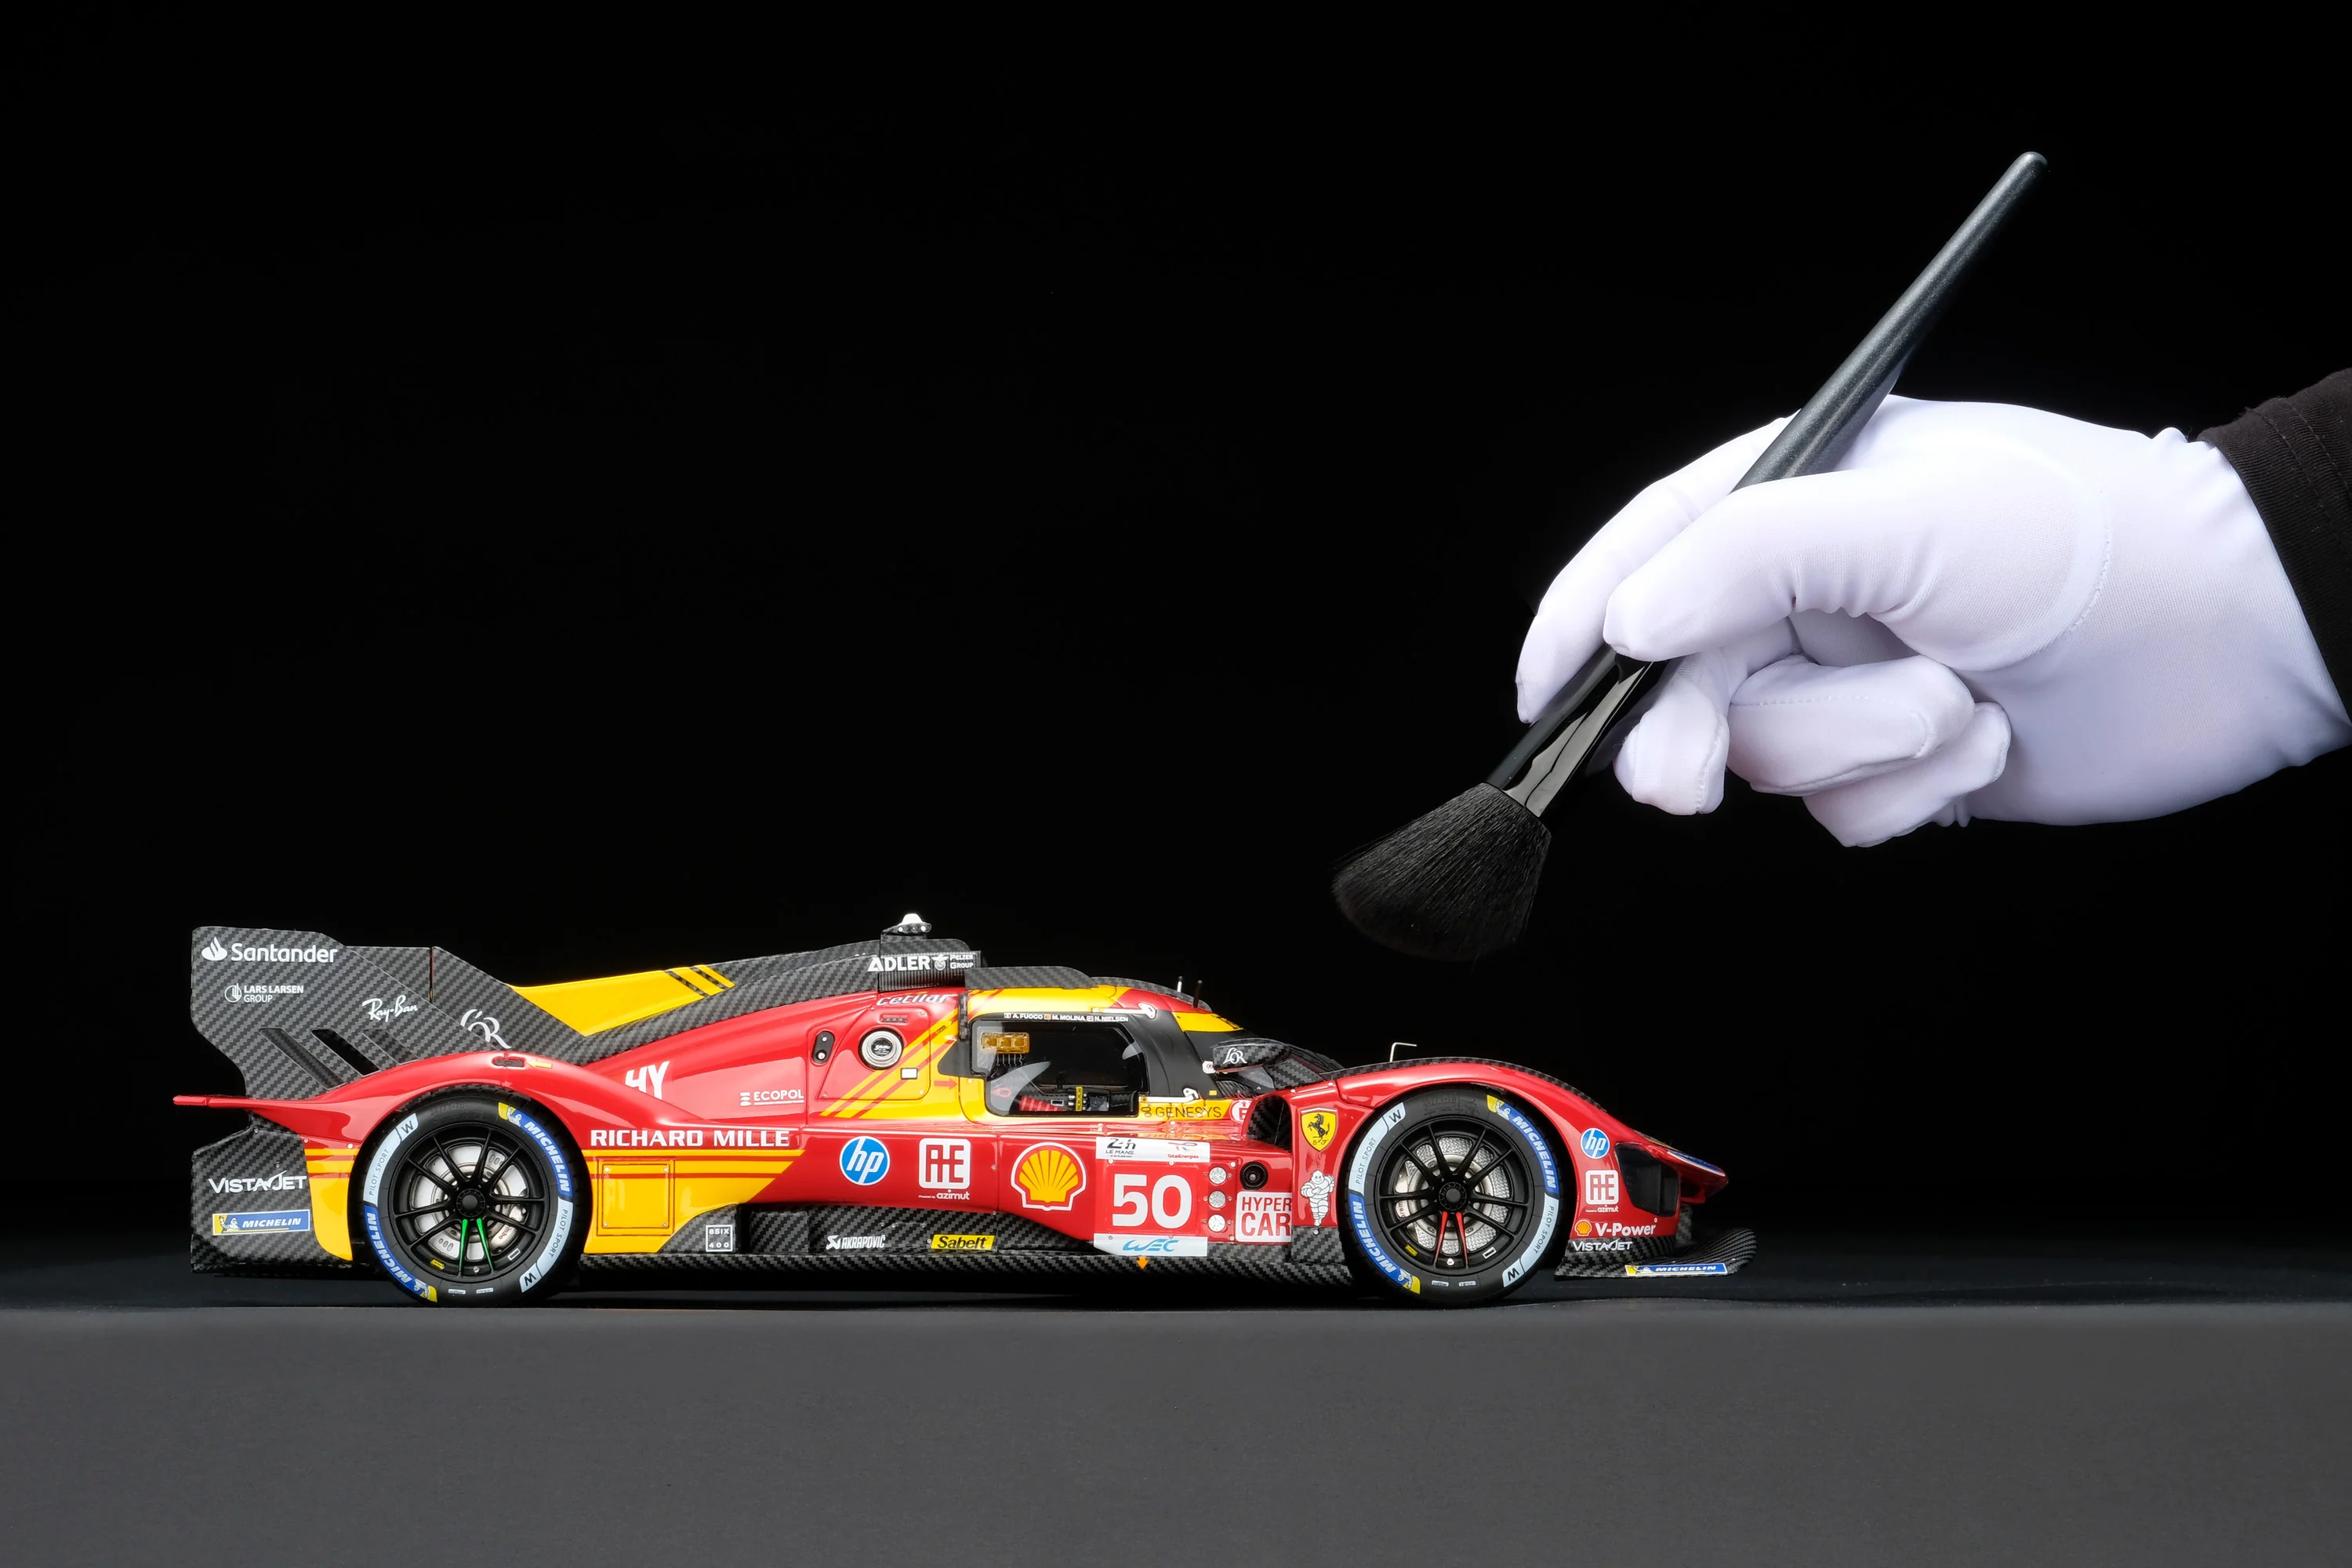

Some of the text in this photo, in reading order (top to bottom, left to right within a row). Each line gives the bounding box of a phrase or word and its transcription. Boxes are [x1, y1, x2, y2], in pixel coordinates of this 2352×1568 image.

[230, 942, 338, 964] Santander
[867, 956, 931, 972] ADLER
[269, 985, 304, 994] LARSEN
[244, 994, 273, 1003] GROUP
[753, 1088, 804, 1102] ECOPOL
[1155, 1106, 1221, 1118] GENESYS
[1388, 1109, 1402, 1123] W
[401, 1120, 414, 1134] W
[590, 1130, 789, 1147] RICHARD MILLE
[1584, 1130, 1606, 1157] hp
[524, 1121, 570, 1192] MICHELIN
[1512, 1116, 1556, 1189] MICHELIN
[846, 1138, 884, 1184] hp
[1356, 1137, 1377, 1185] PILOT SPORT
[368, 1149, 390, 1196] PILOT SPORT
[936, 1189, 970, 1200] azimut
[1112, 1173, 1192, 1229] 50
[1242, 1196, 1292, 1212] HYPER
[1597, 1204, 1619, 1213] azimut
[241, 1218, 302, 1229] MICHELIN
[1241, 1212, 1291, 1236] CAR
[1595, 1222, 1656, 1236] V-Power
[937, 1236, 988, 1249] Sabelt
[1352, 1201, 1397, 1273] MICHELIN
[1534, 1230, 1548, 1254] SPORT
[367, 1212, 412, 1283] MICHELIN
[549, 1233, 563, 1258] SPORT
[1122, 1239, 1179, 1252] WEC
[524, 1272, 537, 1287] W
